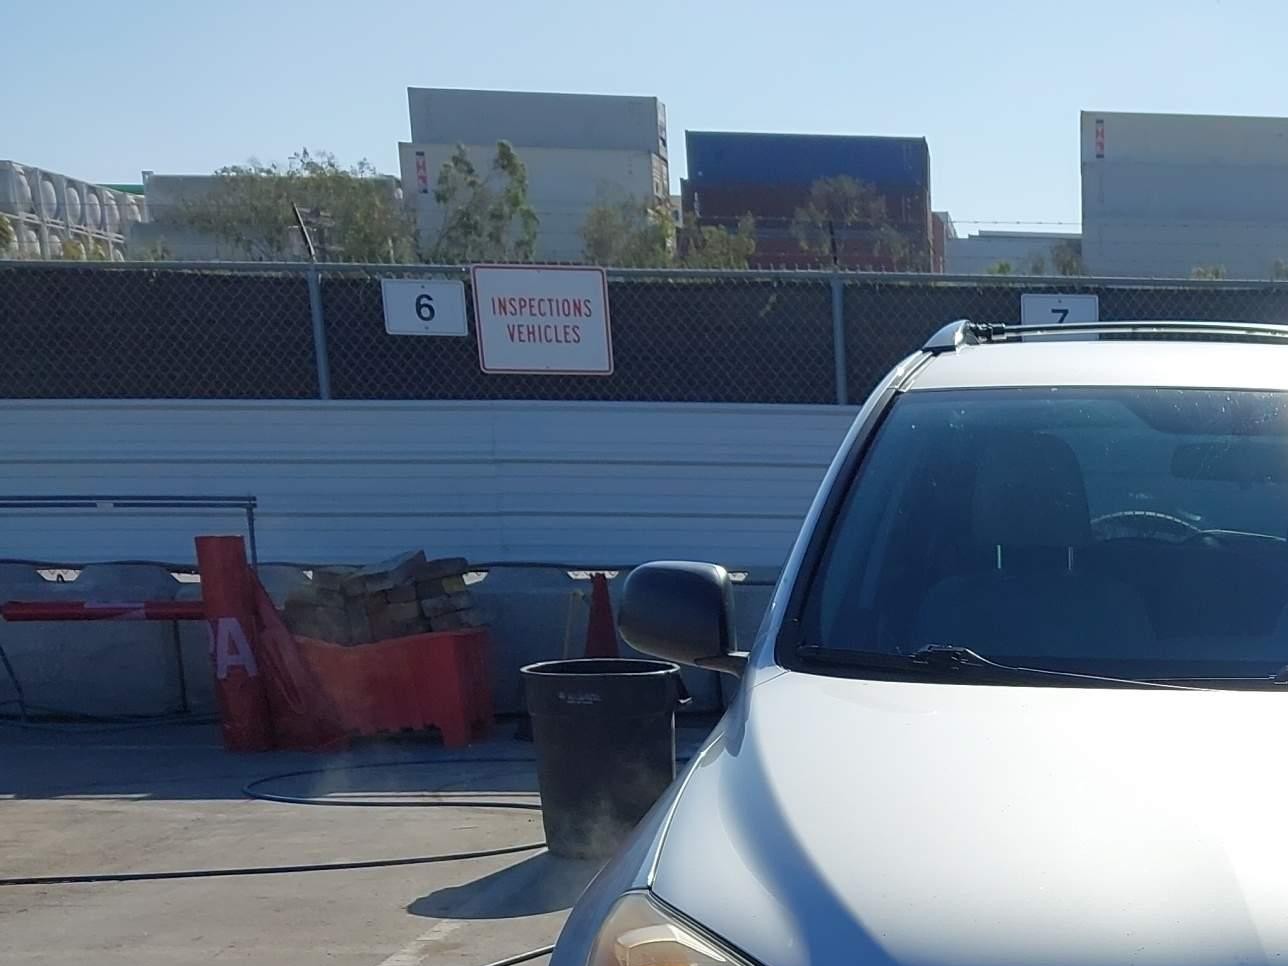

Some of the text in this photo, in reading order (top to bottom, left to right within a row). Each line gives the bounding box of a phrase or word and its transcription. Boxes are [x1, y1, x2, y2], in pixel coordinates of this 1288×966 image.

[415, 294, 436, 321] 6
[491, 296, 593, 318] INSPECTIONS
[1051, 309, 1069, 324] 7
[506, 324, 581, 344] VEHICLES
